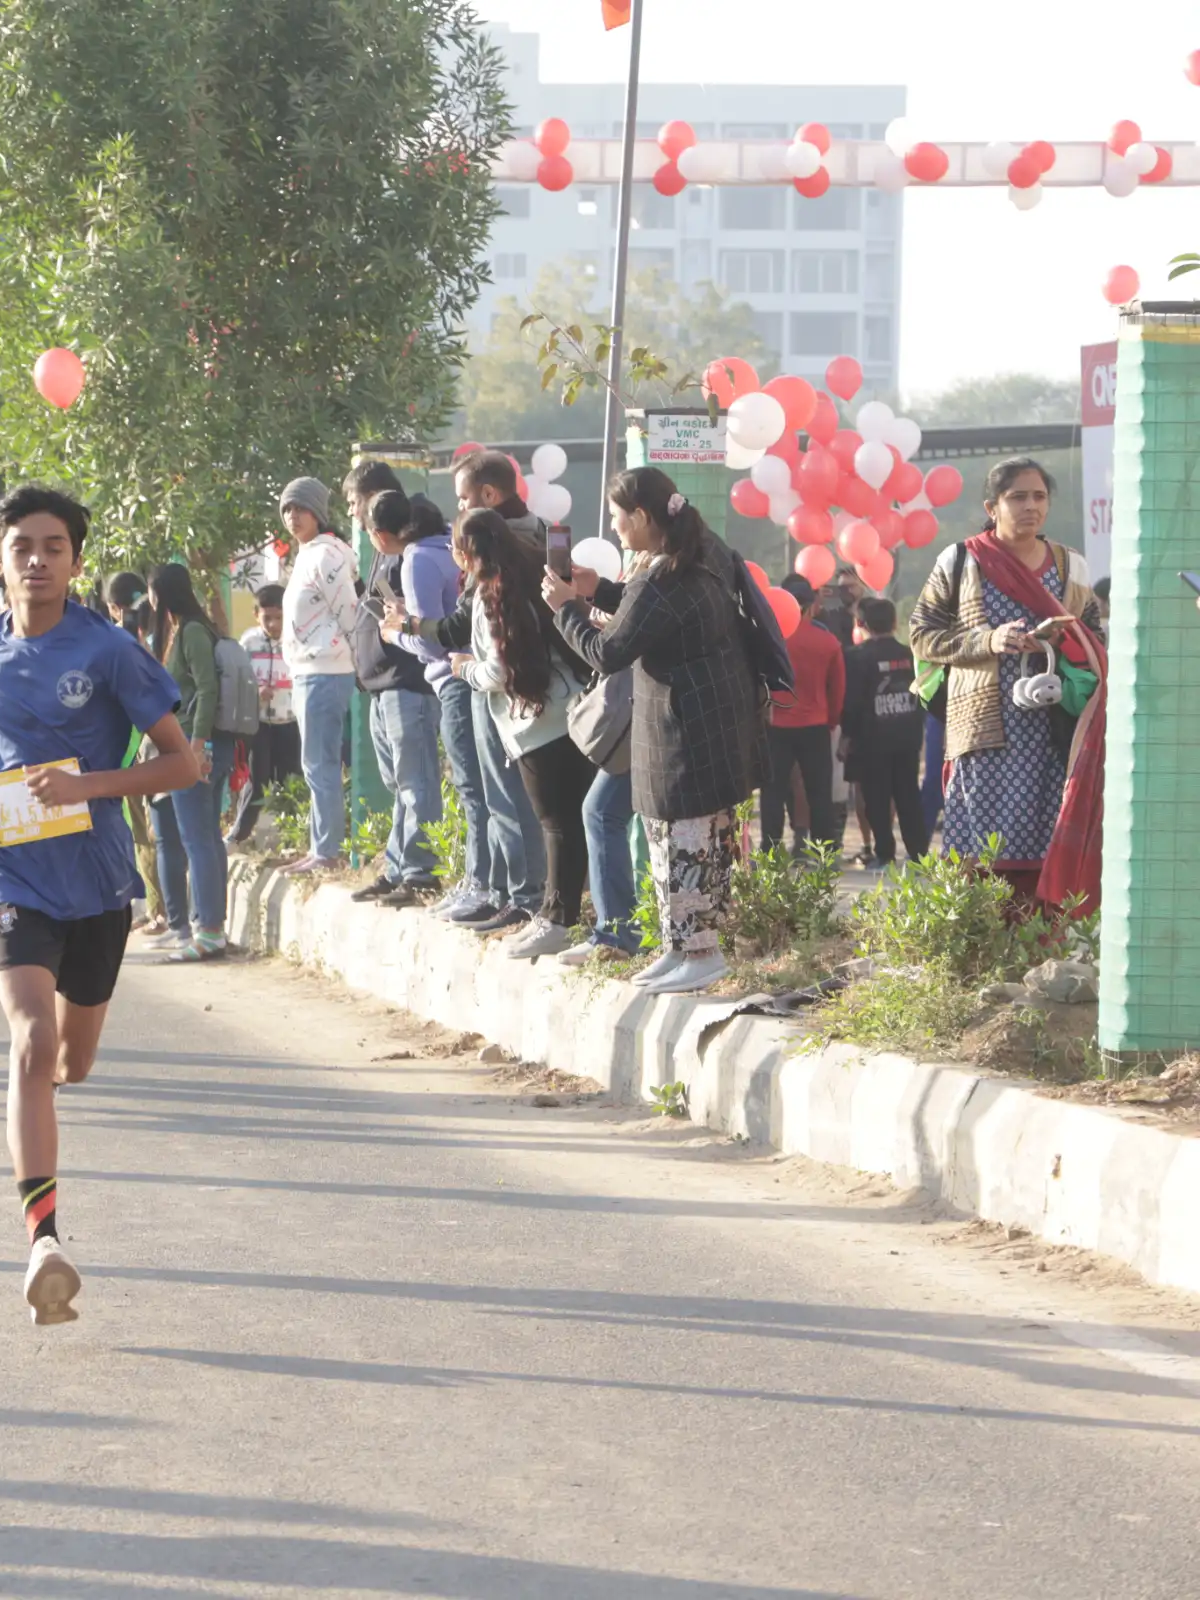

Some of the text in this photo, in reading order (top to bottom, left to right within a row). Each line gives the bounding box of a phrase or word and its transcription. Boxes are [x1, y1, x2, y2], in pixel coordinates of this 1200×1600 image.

[676, 430, 700, 439] VMC
[662, 439, 689, 448] 2024
[699, 440, 712, 449] 25
